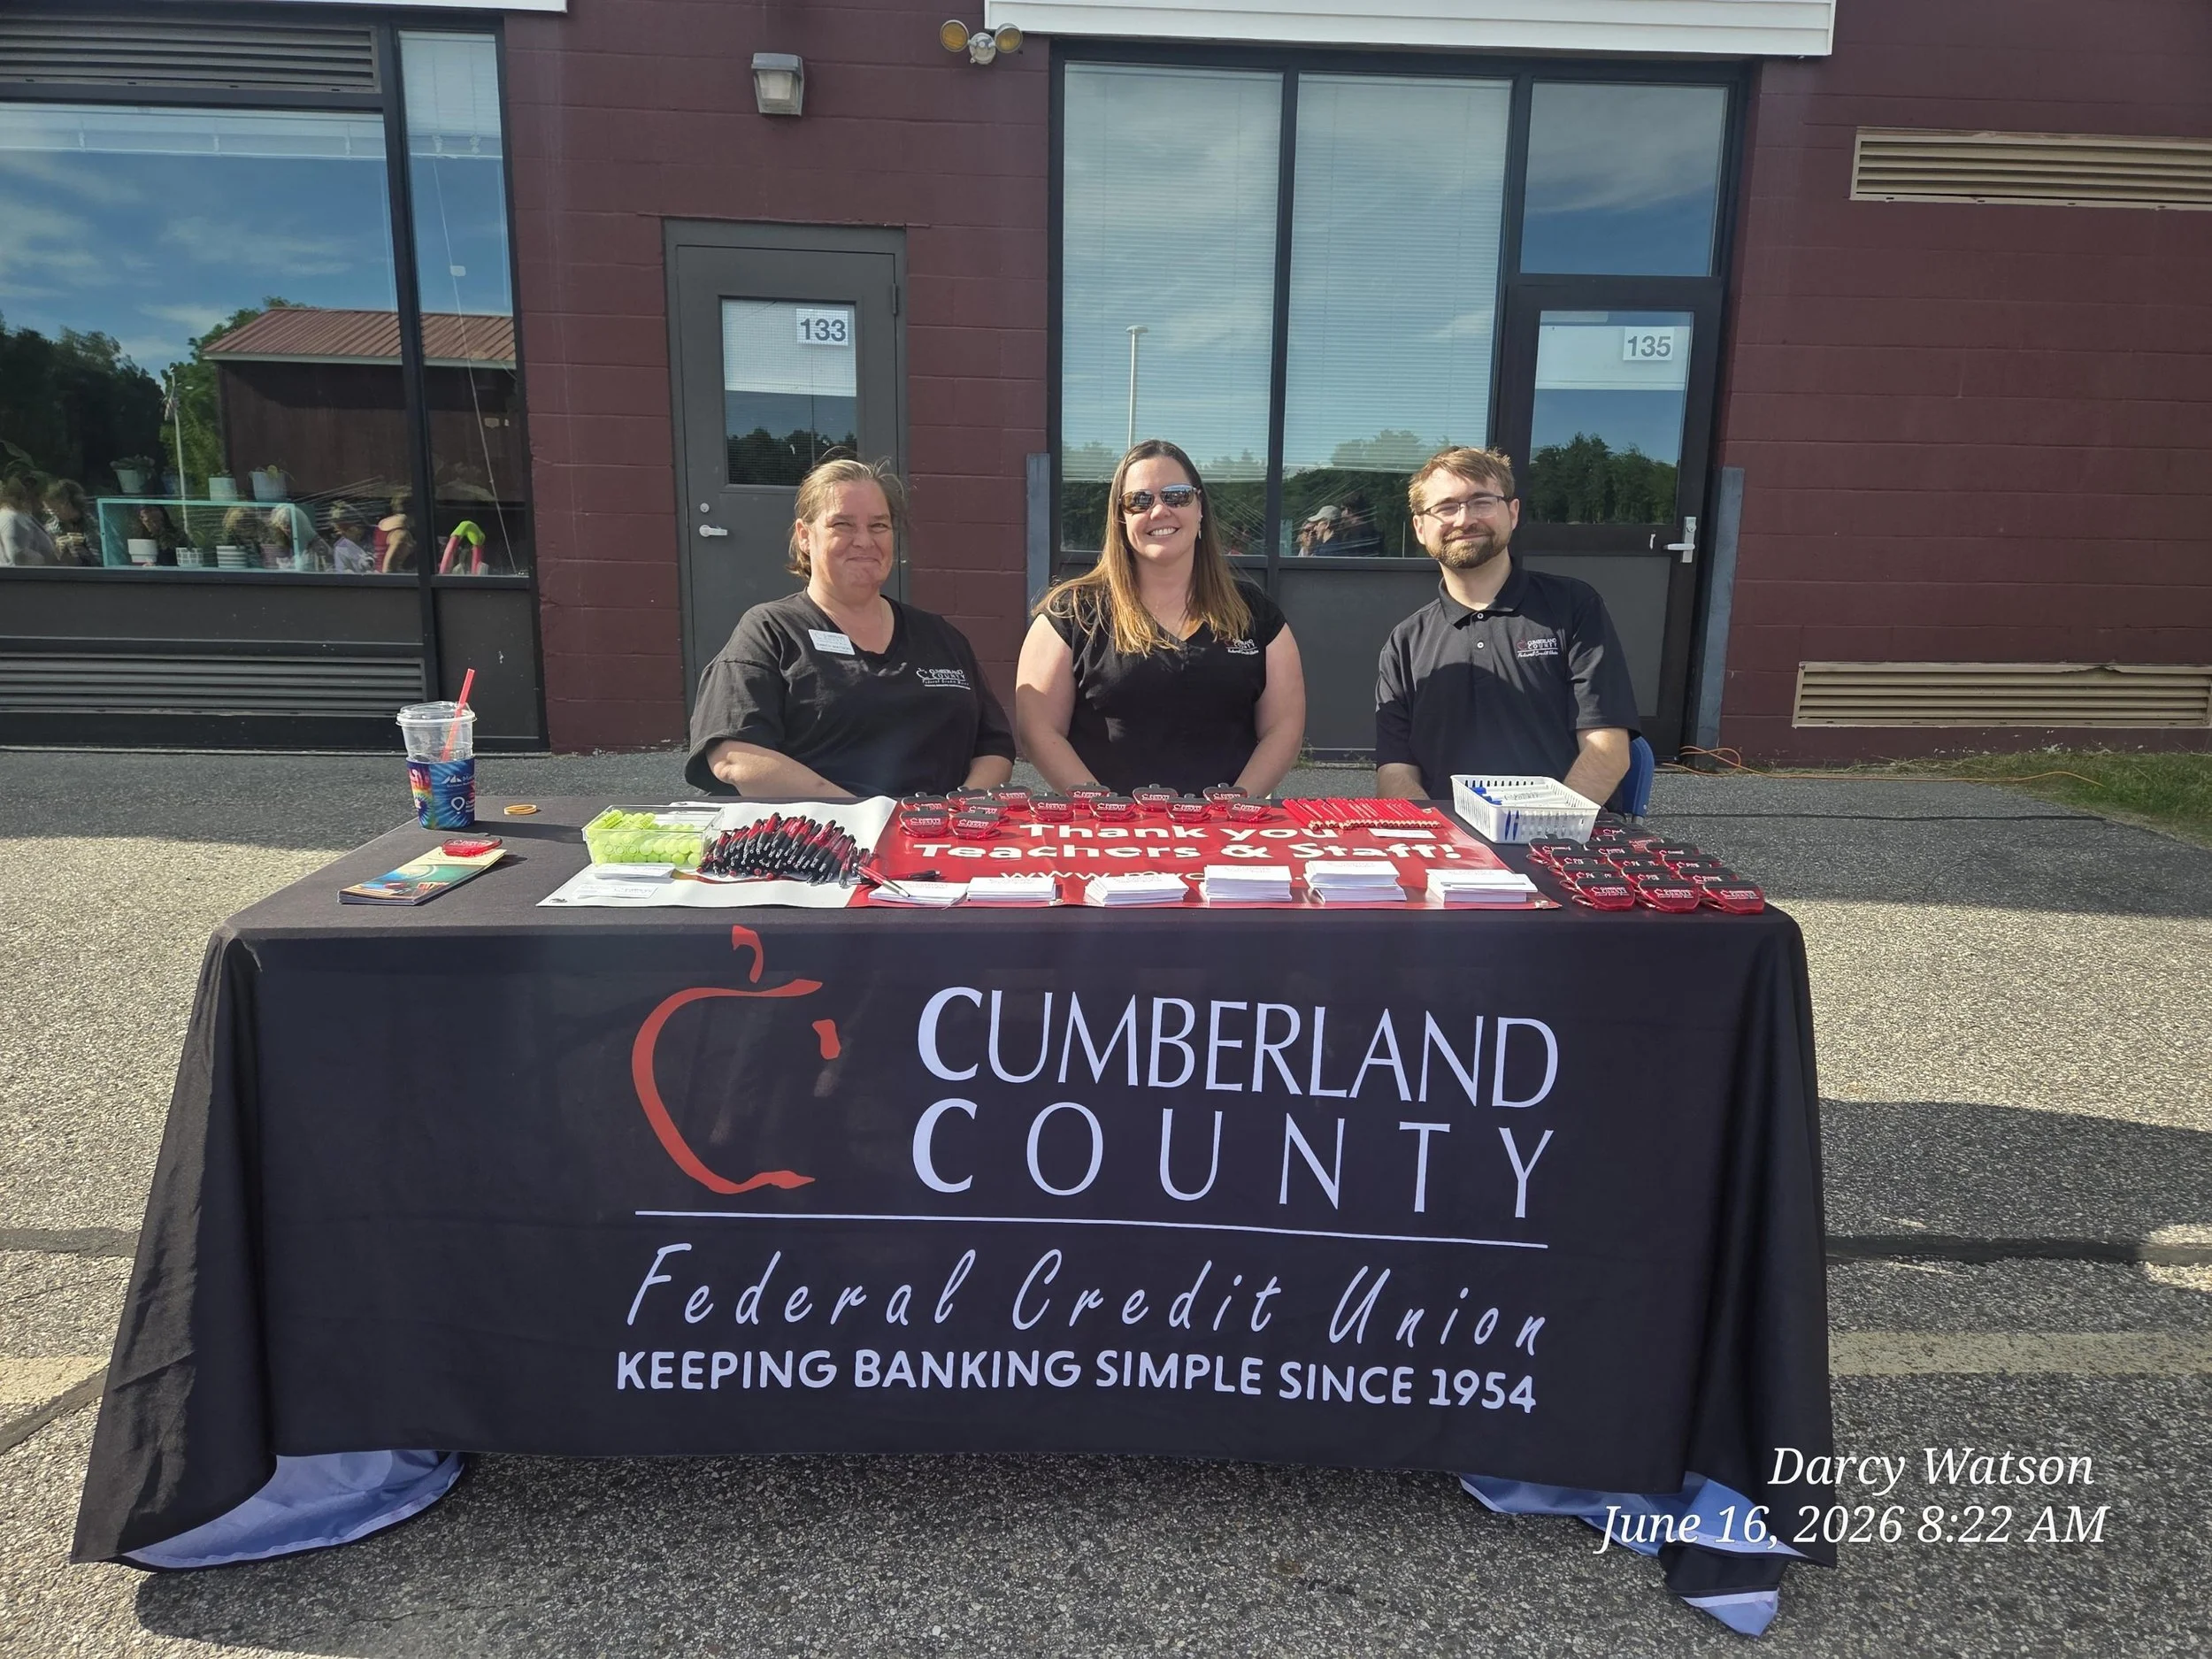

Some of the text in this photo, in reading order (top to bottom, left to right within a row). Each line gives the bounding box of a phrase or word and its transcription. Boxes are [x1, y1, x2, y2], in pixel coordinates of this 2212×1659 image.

[800, 318, 846, 342] 133
[1627, 335, 1671, 357] 135
[913, 842, 1462, 859] Teachers & Staff!
[1018, 823, 1339, 841] Thank you
[918, 986, 1559, 1108] CUMBERLAND
[912, 1097, 1555, 1218] COUNTY
[626, 1242, 1547, 1356] Federal Credit Union
[617, 1348, 1537, 1414] KEEPING BANKING SIMPLE SINCE 1954
